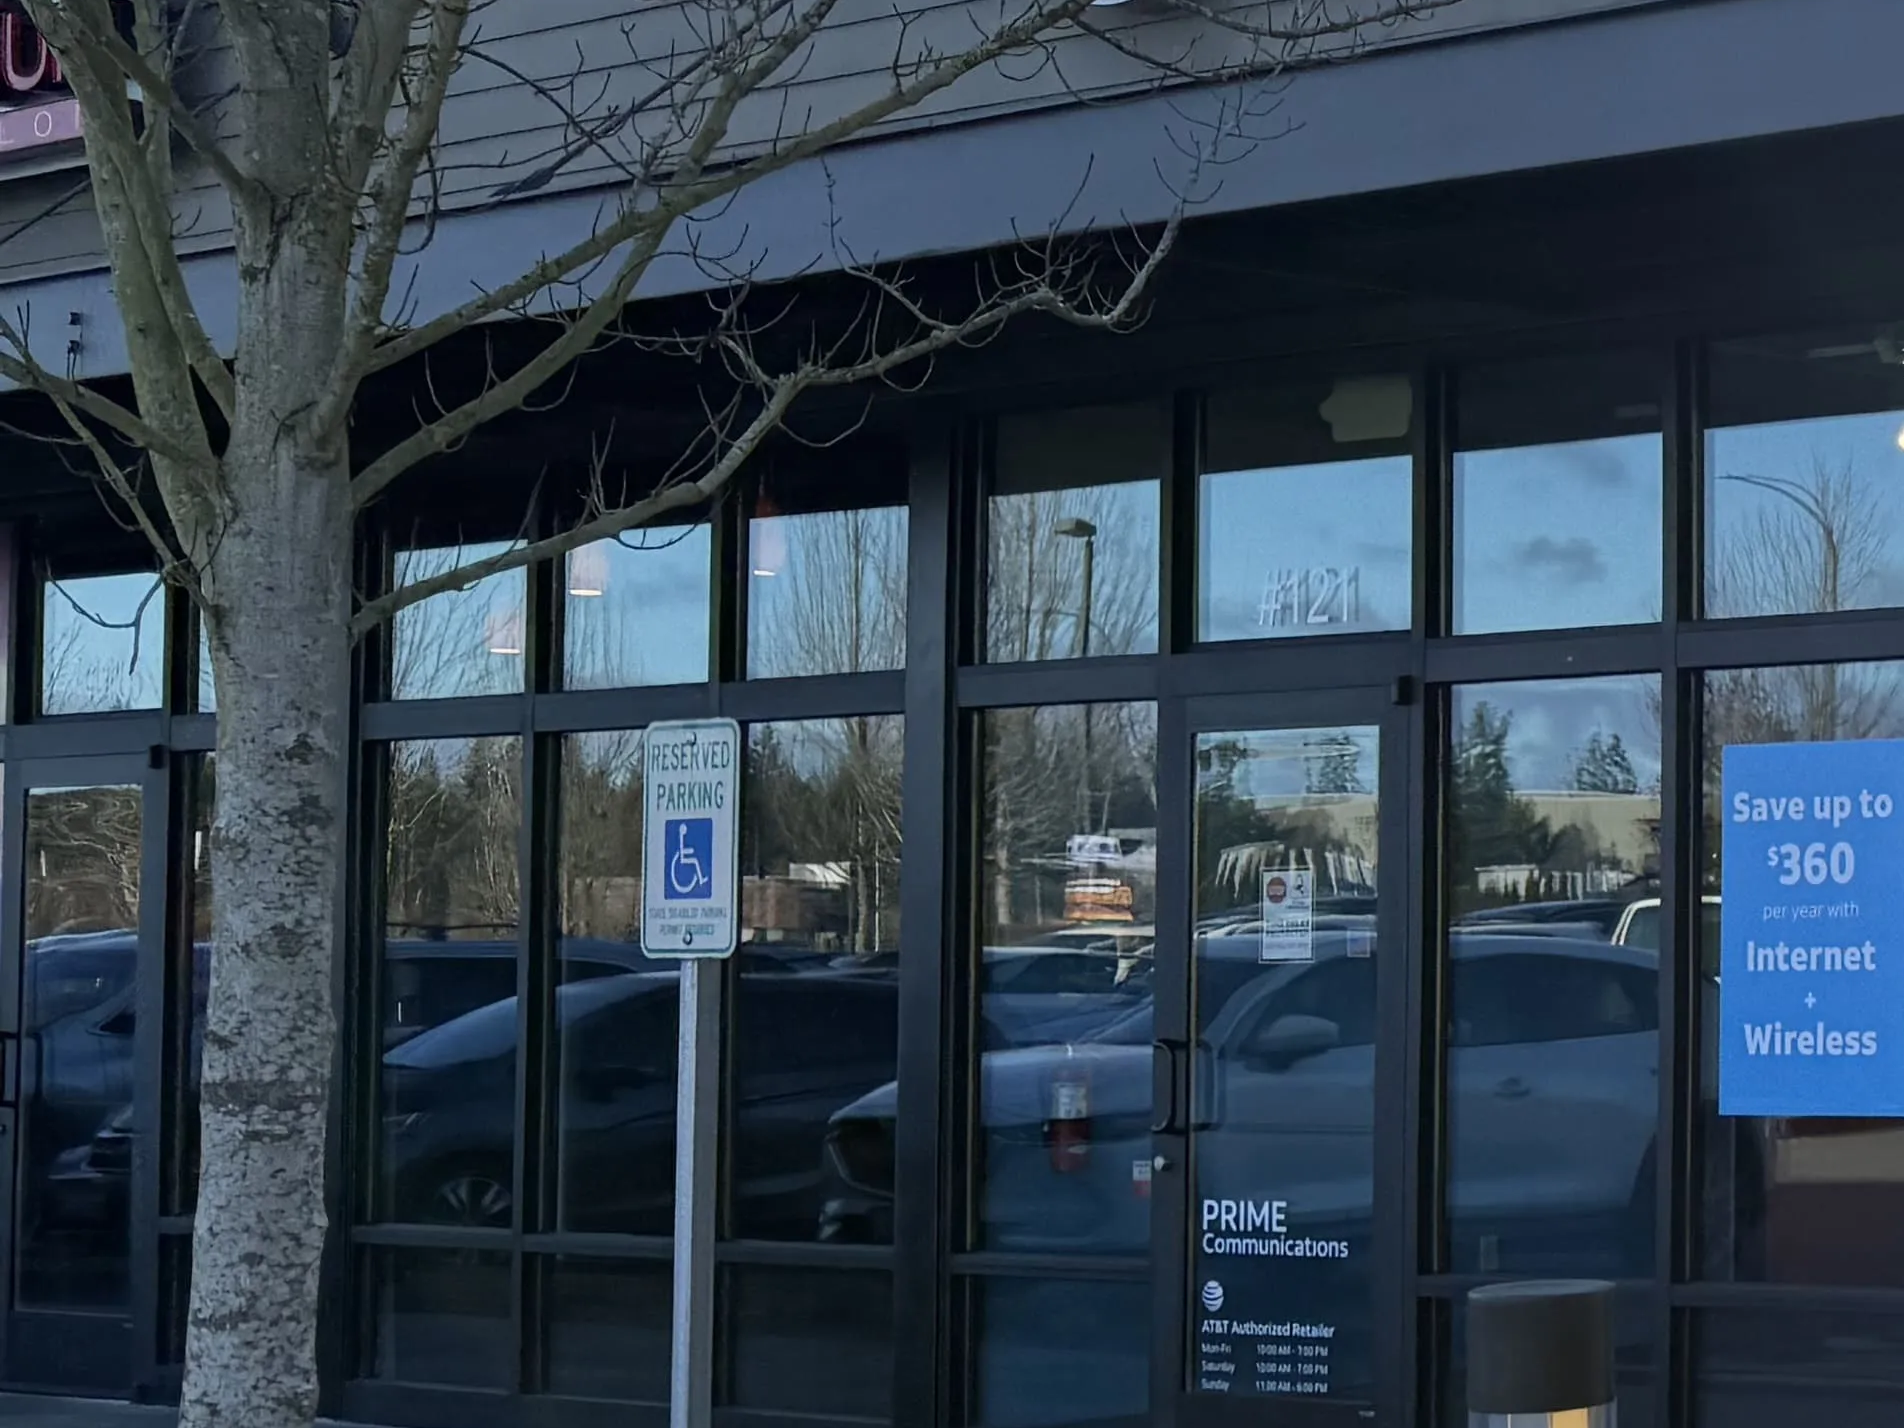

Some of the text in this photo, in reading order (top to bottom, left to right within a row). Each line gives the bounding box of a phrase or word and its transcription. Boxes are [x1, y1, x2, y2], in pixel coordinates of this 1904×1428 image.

[1257, 568, 1350, 626] #121
[651, 741, 730, 771] RESERVED
[656, 781, 724, 812] PARKING
[1733, 789, 1894, 828] Save up to
[1767, 841, 1855, 886] $360
[1763, 899, 1860, 921] per year with
[1746, 940, 1877, 972] Internet
[1804, 991, 1817, 1009] +
[1743, 1021, 1878, 1056] Wireless
[1202, 1199, 1288, 1233] PRIME
[1202, 1233, 1349, 1258] Communications
[1202, 1320, 1335, 1338] AT&T Authorized Retailer
